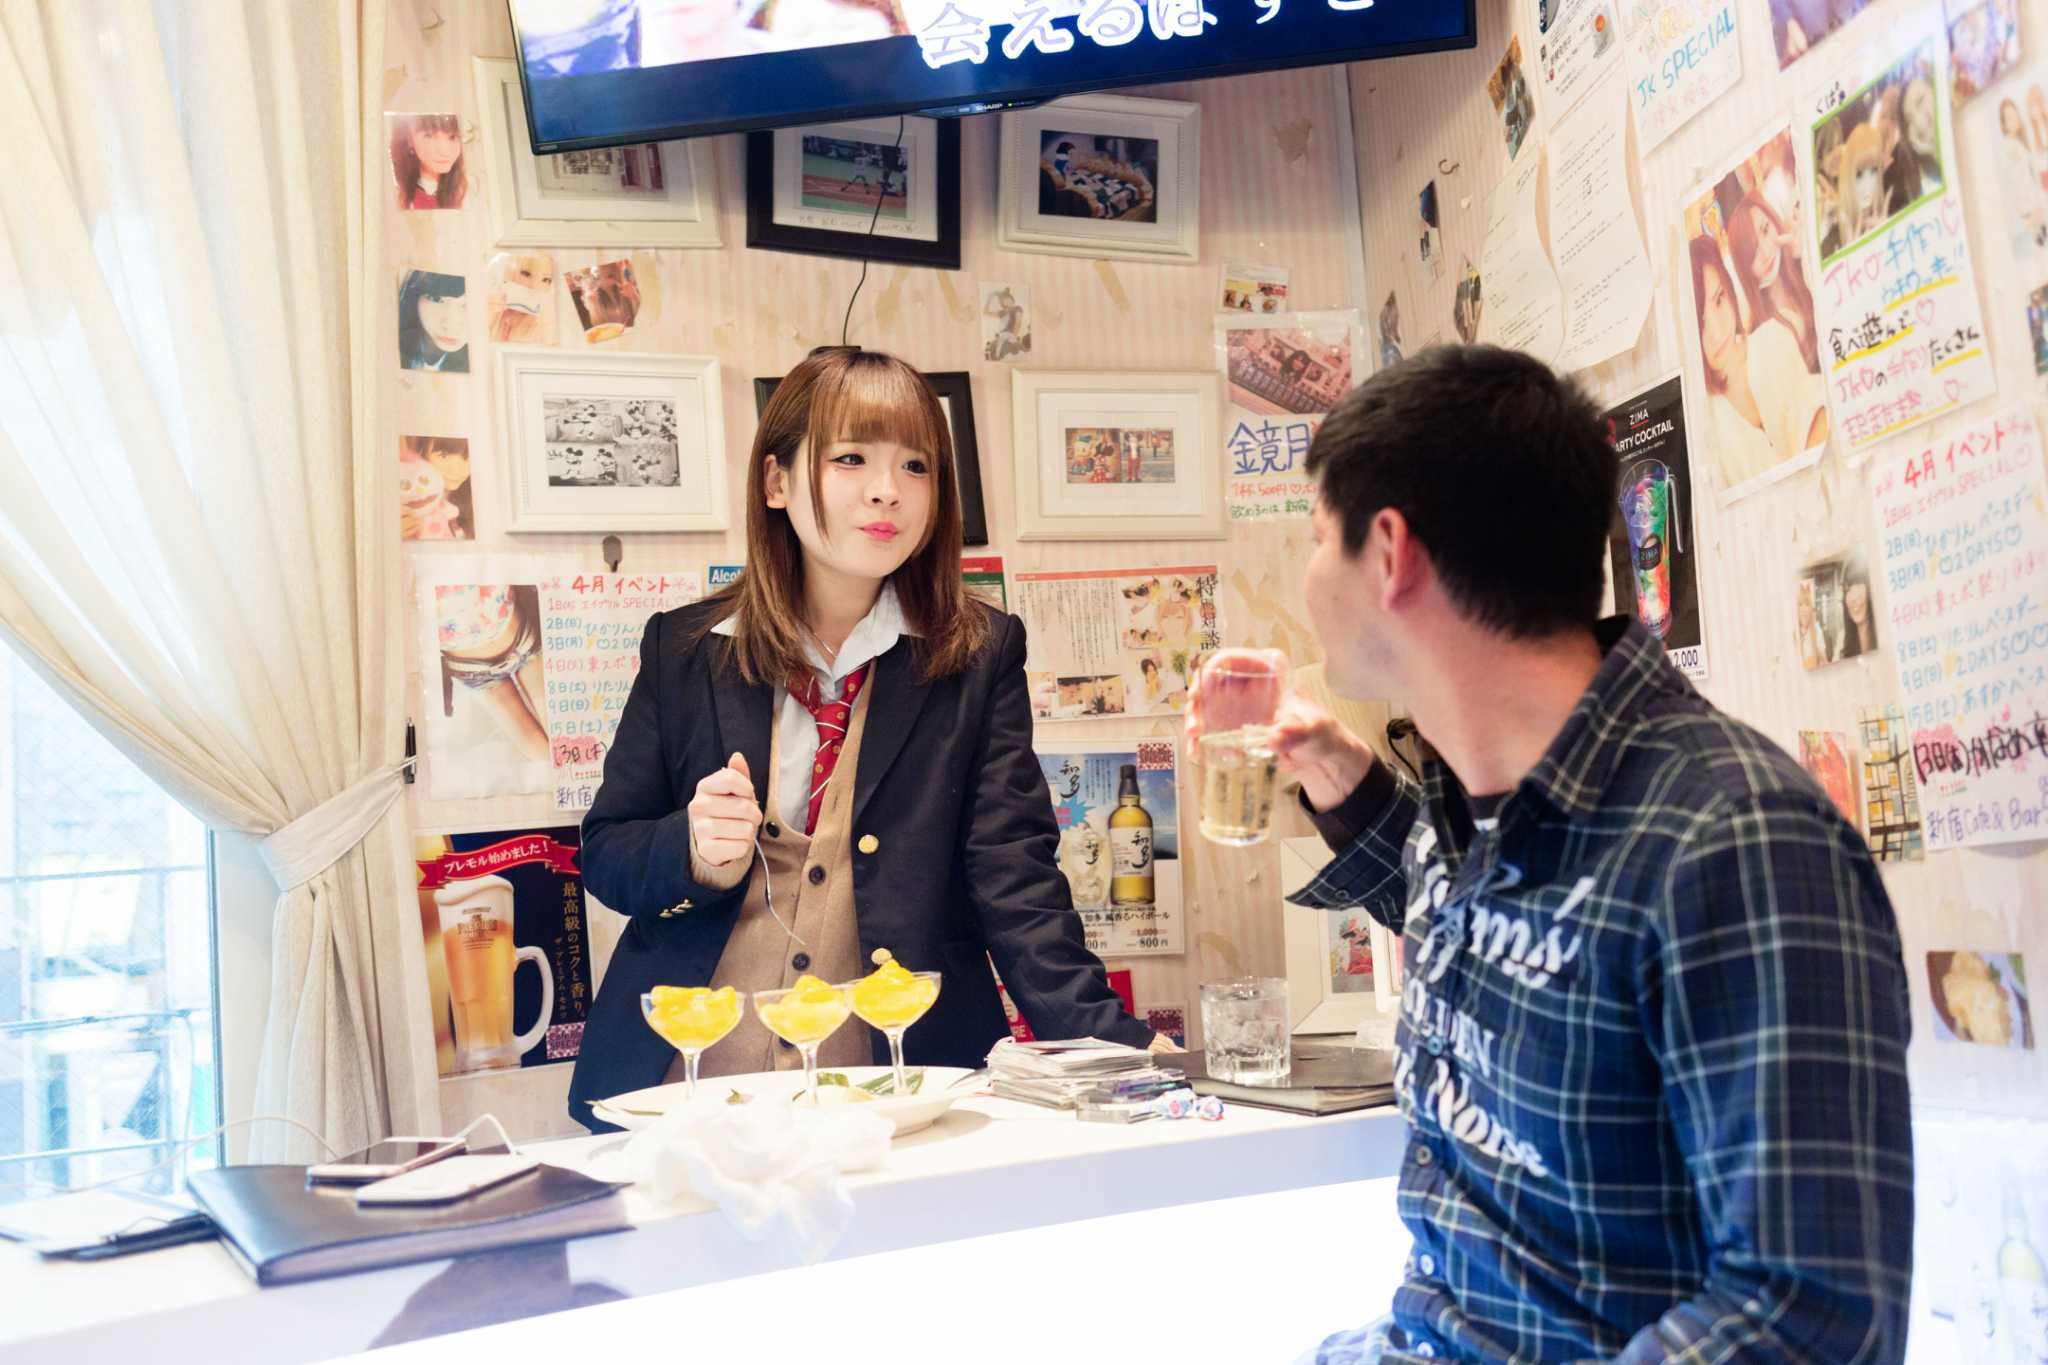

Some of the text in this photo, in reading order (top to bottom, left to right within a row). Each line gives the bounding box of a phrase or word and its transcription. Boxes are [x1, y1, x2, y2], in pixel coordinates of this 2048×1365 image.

[1637, 74, 1656, 107] JK
[1663, 8, 1734, 88] SPECIAL
[1629, 408, 1649, 425] ZIMA
[1227, 419, 1310, 475] 鏡月
[1615, 419, 1675, 452] ARTY COCKTAIL
[1904, 420, 2005, 489] 4月 イベント
[571, 575, 671, 594] 4月 イベント
[623, 596, 672, 610] SPECIAL
